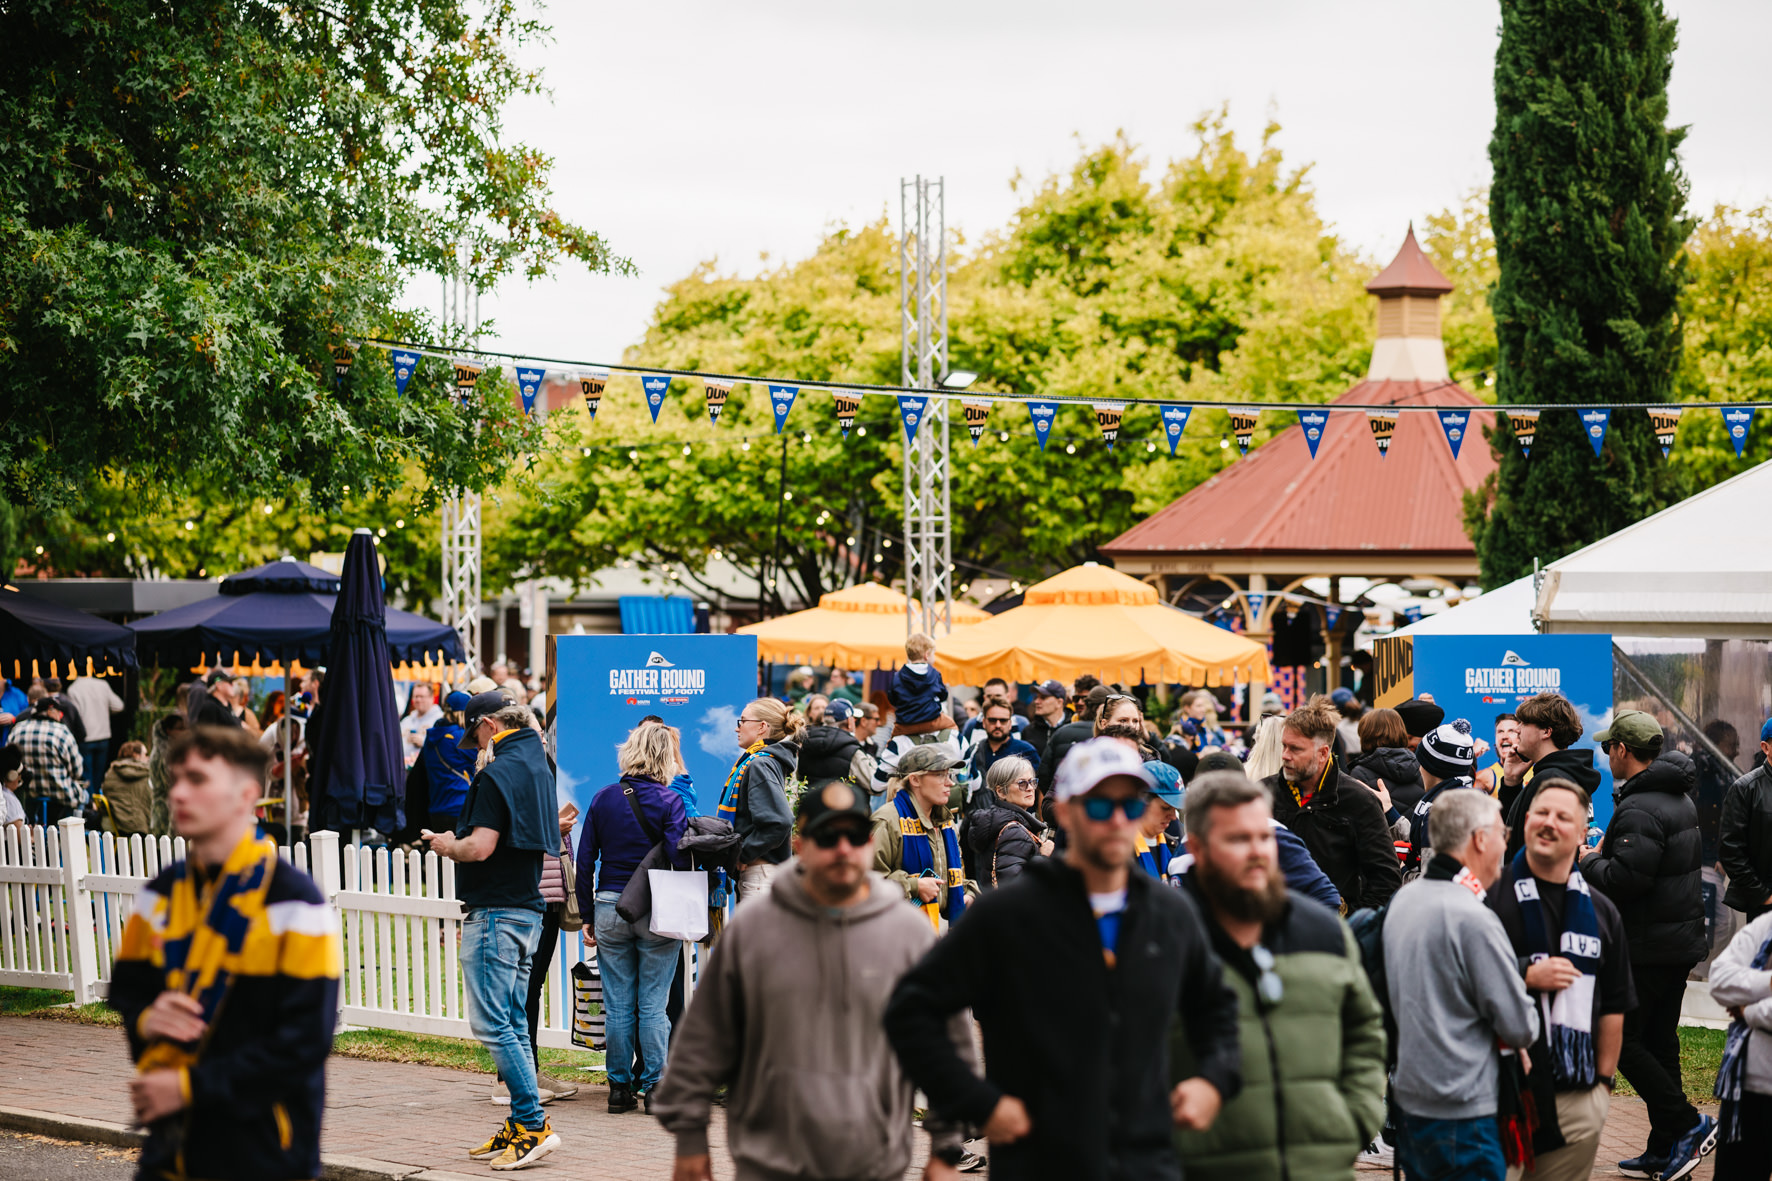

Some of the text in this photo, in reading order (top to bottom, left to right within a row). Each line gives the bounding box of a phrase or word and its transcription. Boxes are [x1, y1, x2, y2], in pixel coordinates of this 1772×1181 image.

[1373, 637, 1413, 700] ROUND
[1465, 668, 1560, 688] GATHER ROUND
[609, 669, 705, 689] GATHER ROUND
